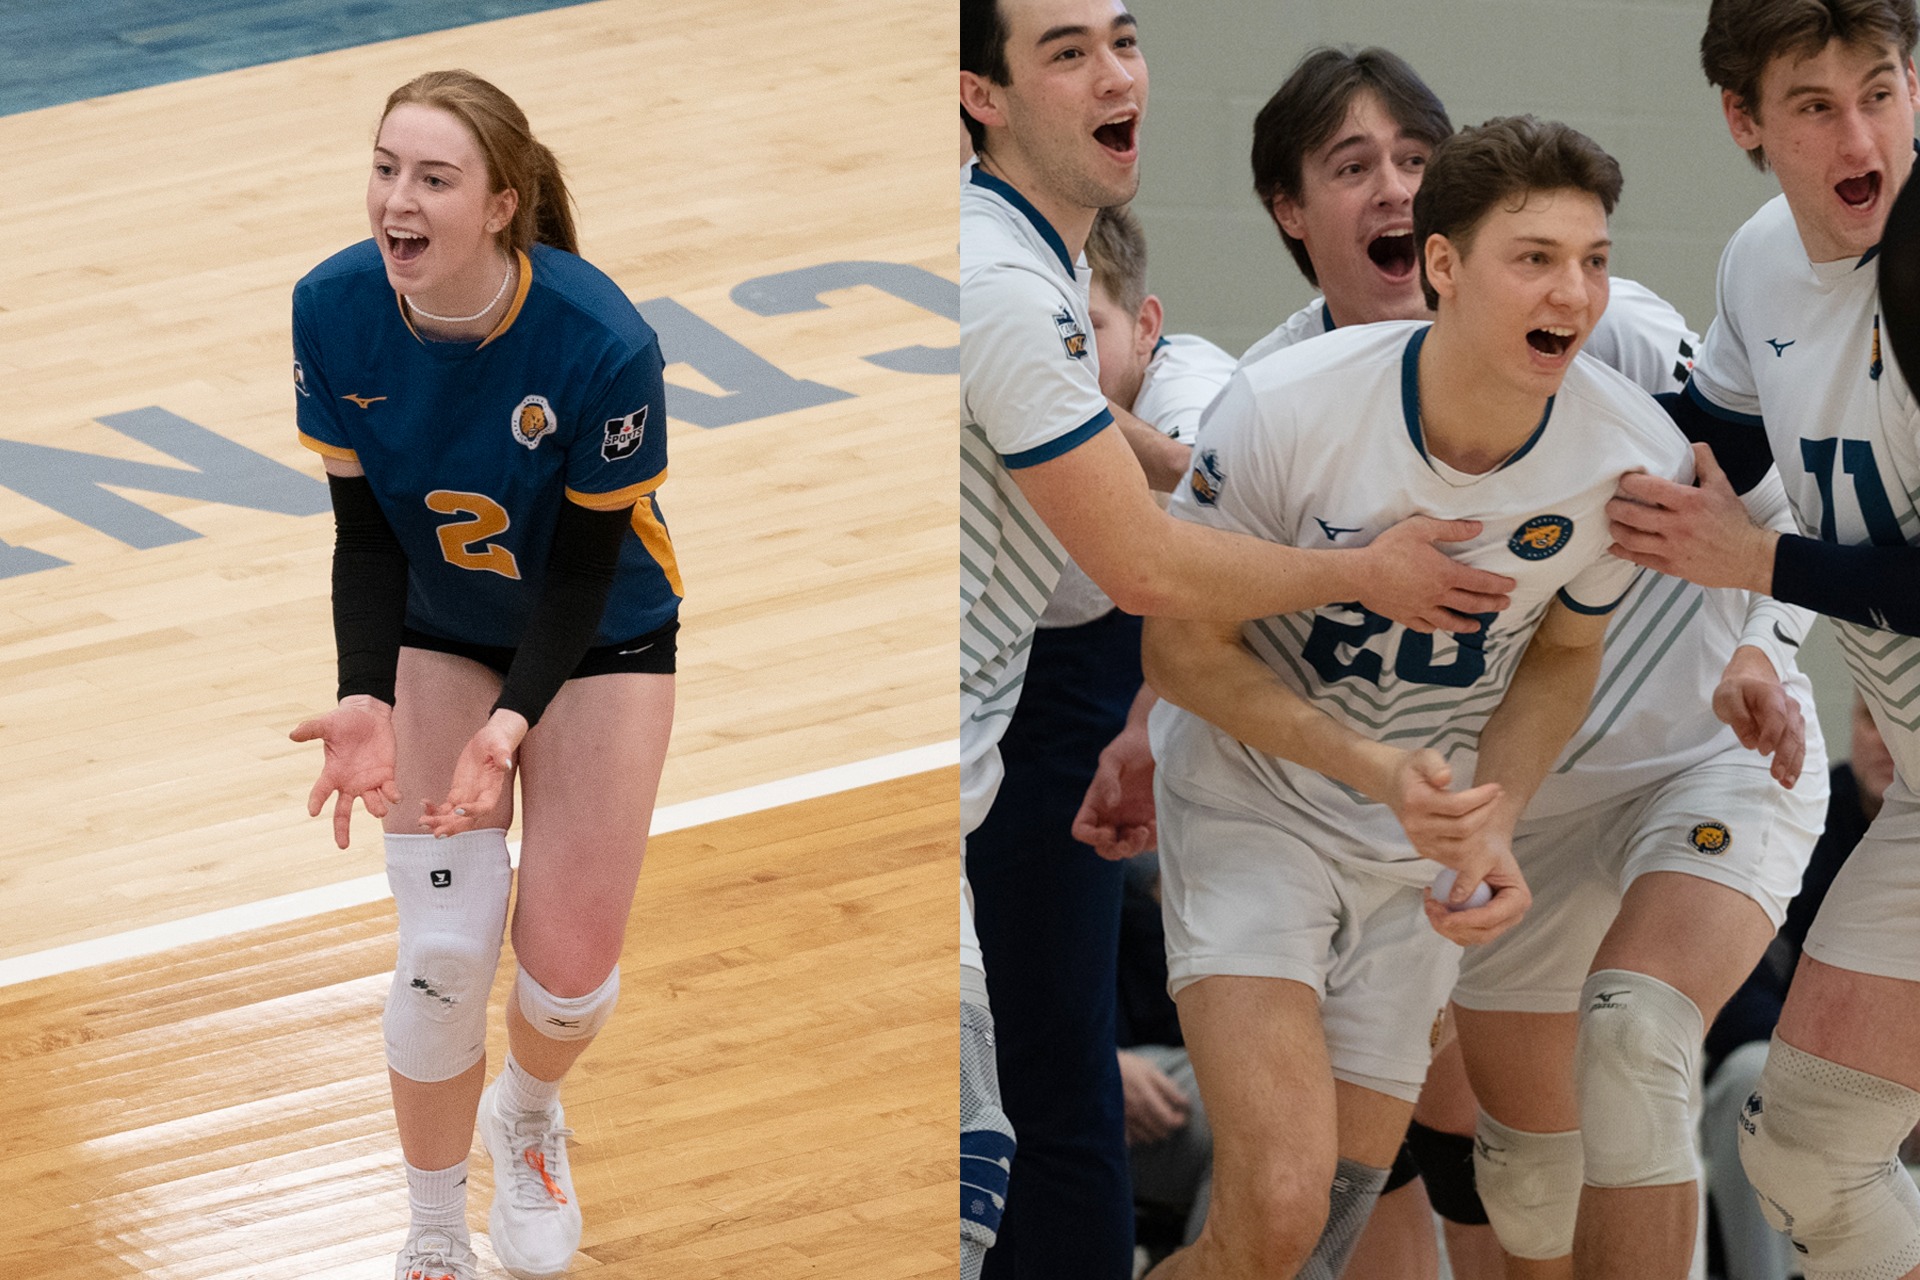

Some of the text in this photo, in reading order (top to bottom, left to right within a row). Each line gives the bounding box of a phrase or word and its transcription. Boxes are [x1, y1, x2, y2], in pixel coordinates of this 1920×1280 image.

[605, 426, 643, 445] SPORTS
[424, 489, 521, 580] 2
[1800, 436, 1908, 545] 11
